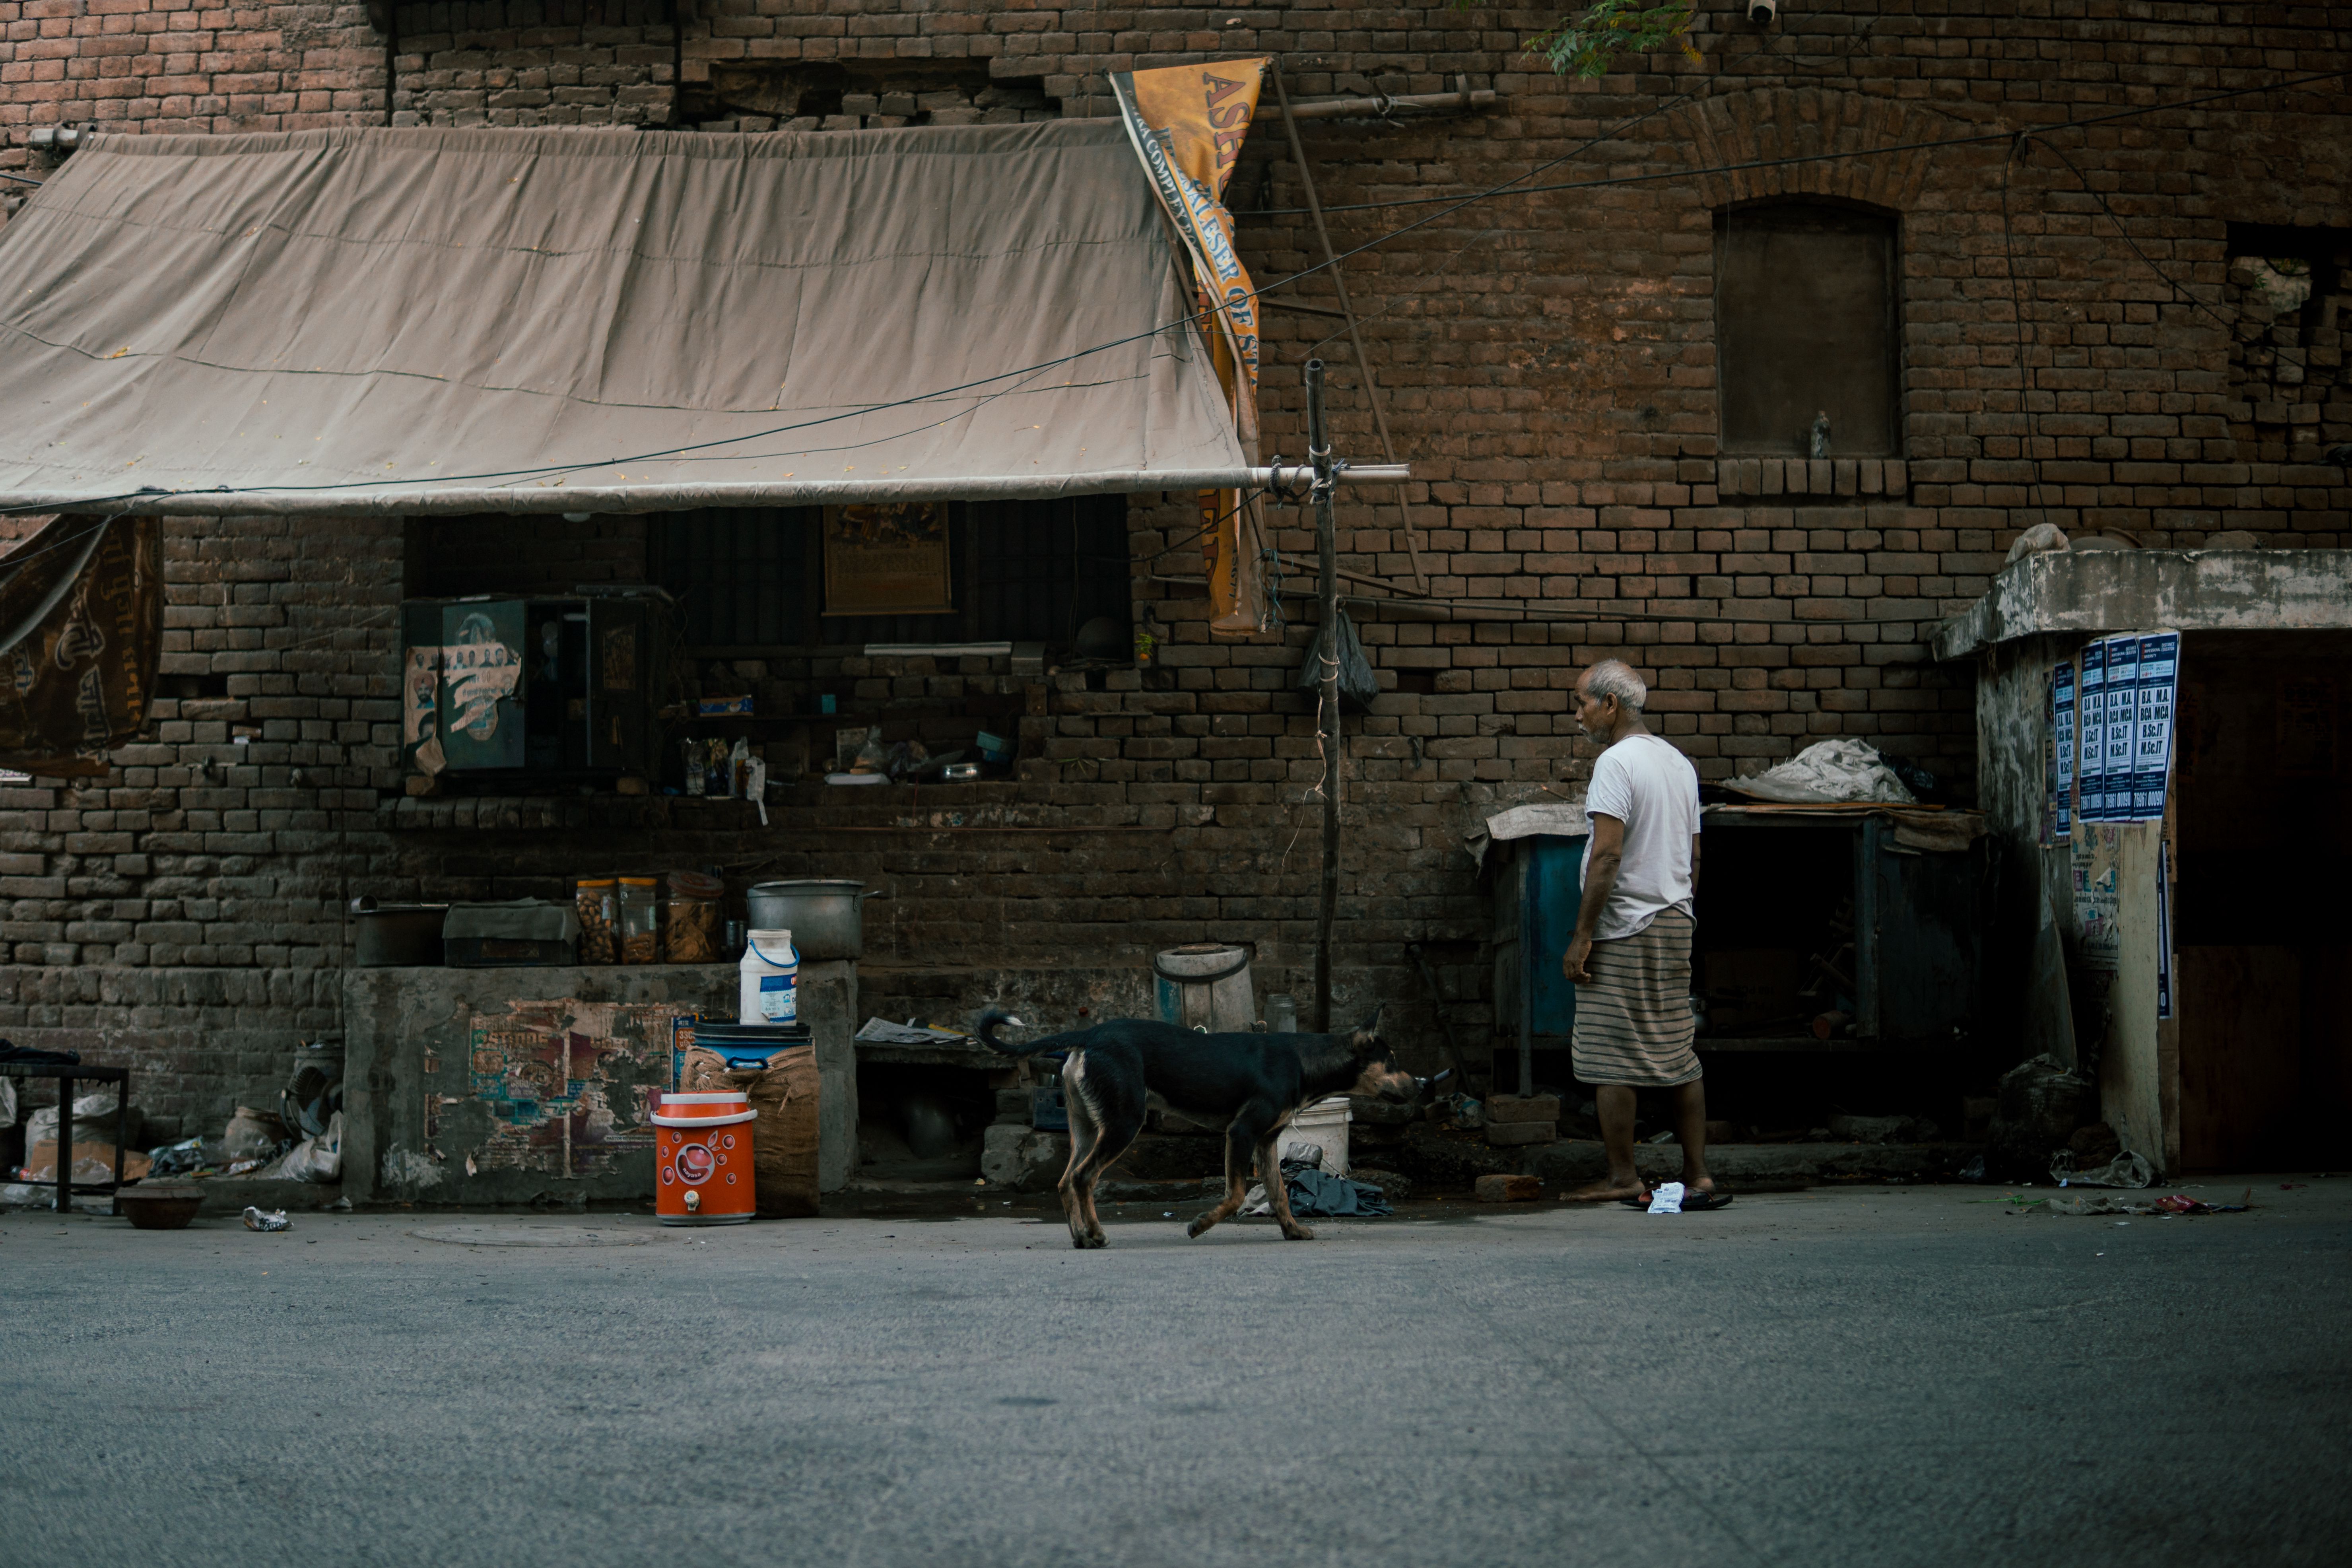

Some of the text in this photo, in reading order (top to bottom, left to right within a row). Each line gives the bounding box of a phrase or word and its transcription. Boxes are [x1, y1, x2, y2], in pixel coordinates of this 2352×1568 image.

[1146, 139, 1189, 223] COMPLEX
[1227, 287, 1254, 326] OF
[1236, 335, 1259, 388] ST
[2093, 695, 2101, 709] M.A.
[2121, 692, 2132, 705] M.A.
[2142, 689, 2169, 704] B.A. M.A.
[2092, 711, 2101, 726] MCA
[2109, 708, 2132, 724] BCA MCA
[2140, 705, 2169, 721] BCA MCA
[2111, 725, 2127, 740] B.Sc.IT
[2143, 723, 2163, 738] B.Sc.IT
[2110, 742, 2127, 757] M.Sc.IT
[2141, 740, 2162, 755] M.Sc.IT
[2105, 791, 2131, 809] 76961 00090
[2134, 790, 2163, 808] 76961 00090
[682, 1168, 701, 1178] nayasa
